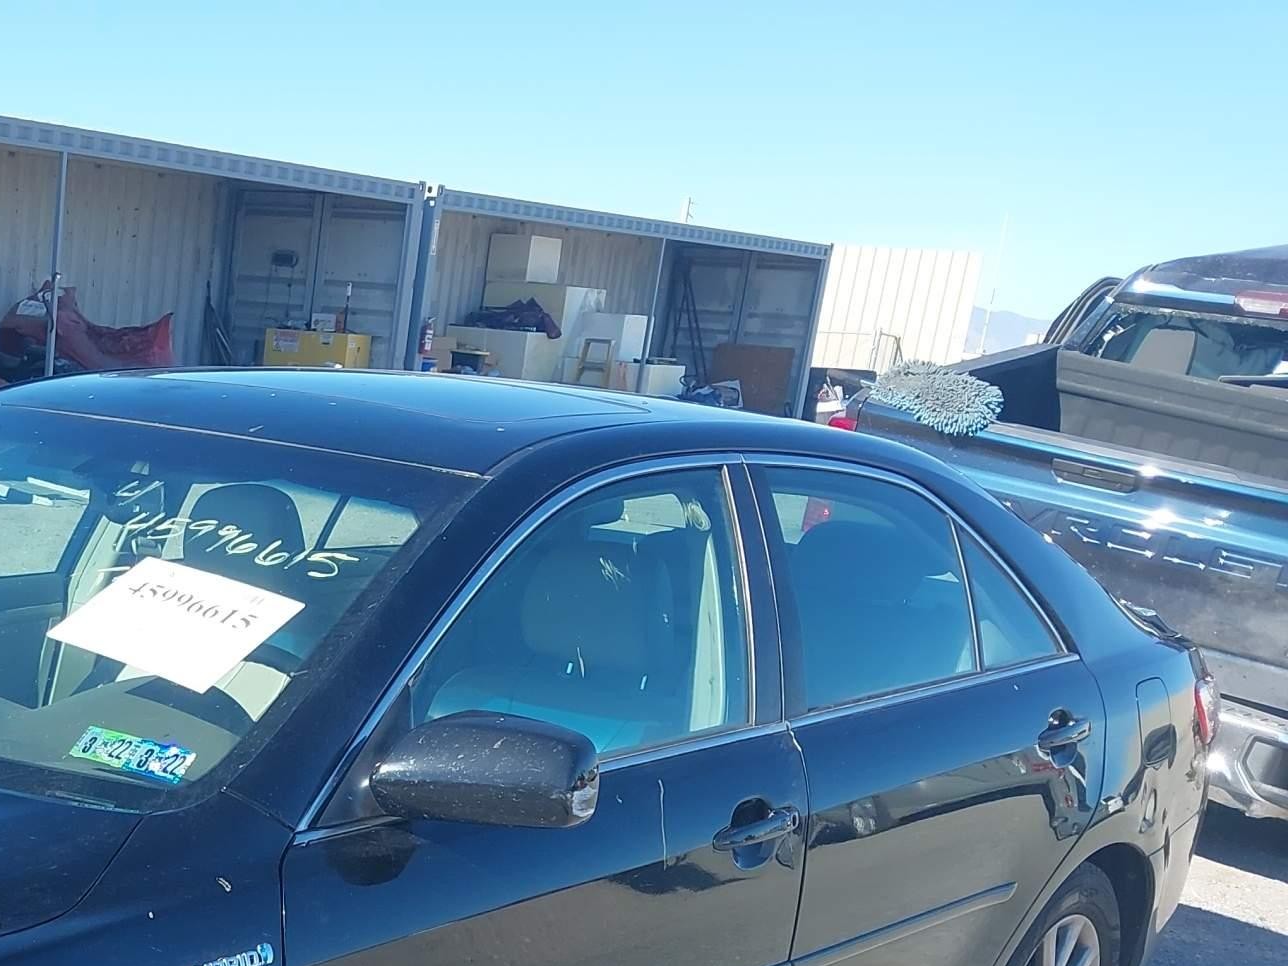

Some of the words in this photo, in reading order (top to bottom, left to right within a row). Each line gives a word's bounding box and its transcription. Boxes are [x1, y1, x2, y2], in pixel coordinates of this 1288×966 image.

[115, 511, 360, 578] 45996615
[129, 581, 259, 630] 45996615
[108, 738, 133, 760] 22
[162, 753, 187, 776] 22
